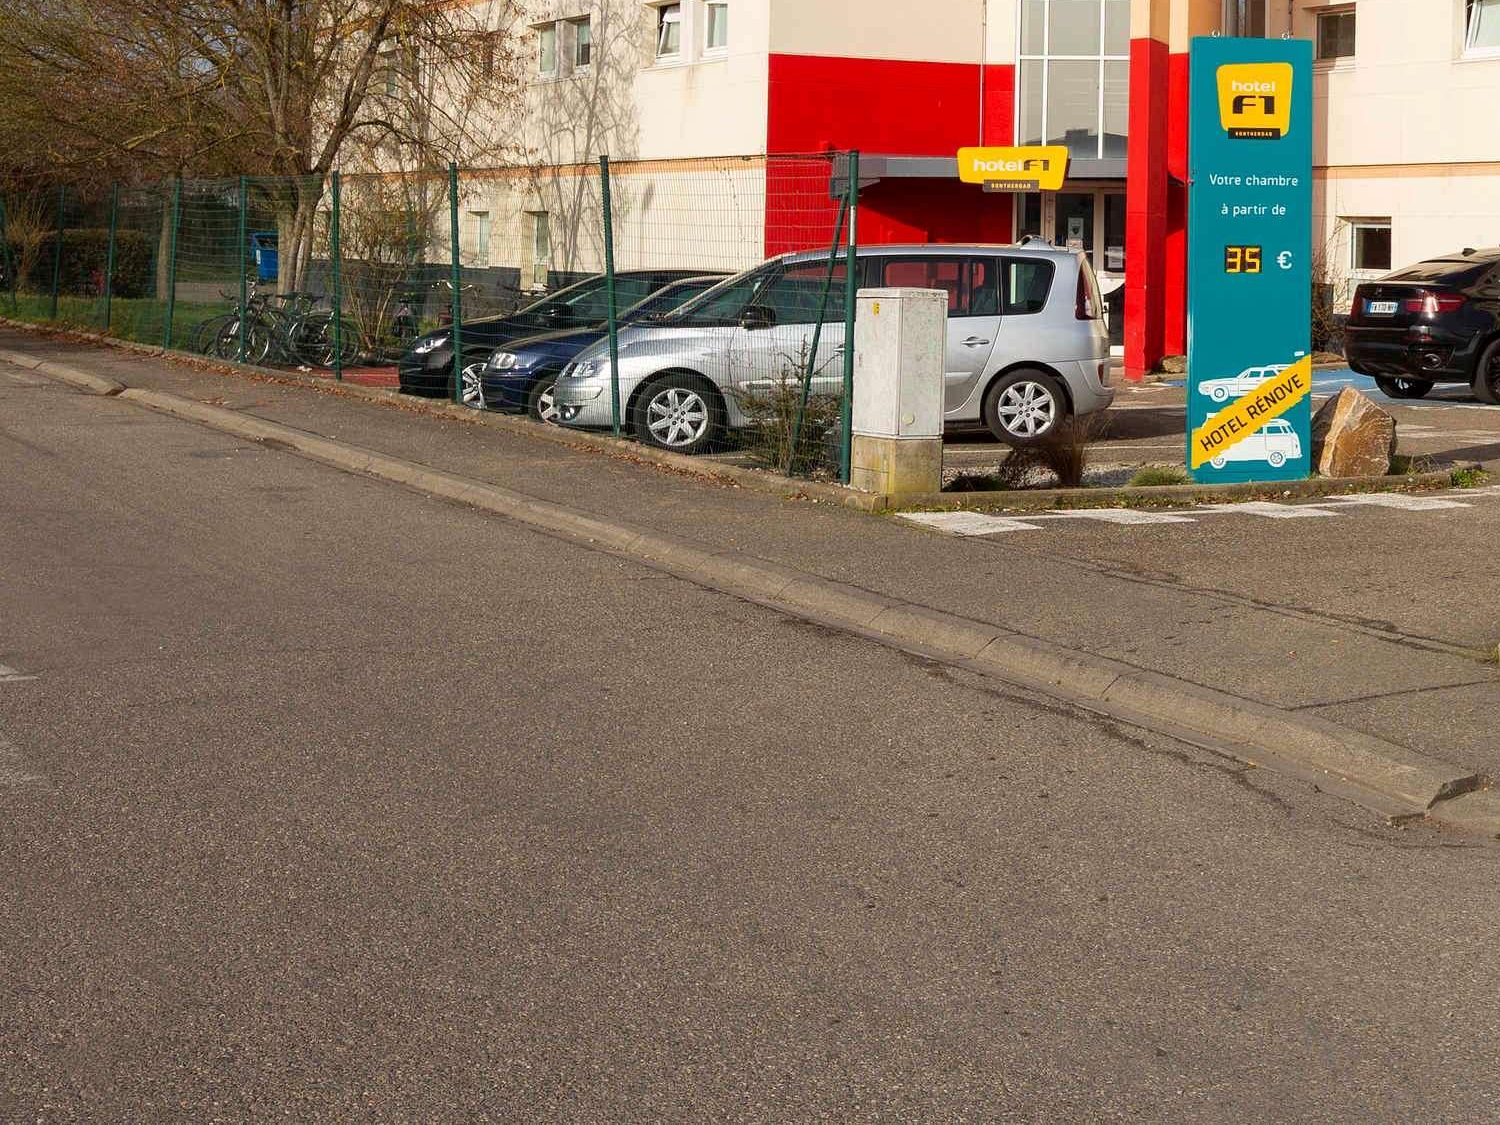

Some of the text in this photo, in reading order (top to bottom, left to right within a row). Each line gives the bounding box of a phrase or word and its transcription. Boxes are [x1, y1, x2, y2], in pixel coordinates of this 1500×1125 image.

[1231, 80, 1276, 92] hotel
[1232, 95, 1276, 115] F1
[1209, 174, 1298, 186] Votre chambre
[1221, 203, 1286, 217] à partir de
[1226, 247, 1293, 273] 35 €
[1200, 415, 1248, 451] HOTEL
